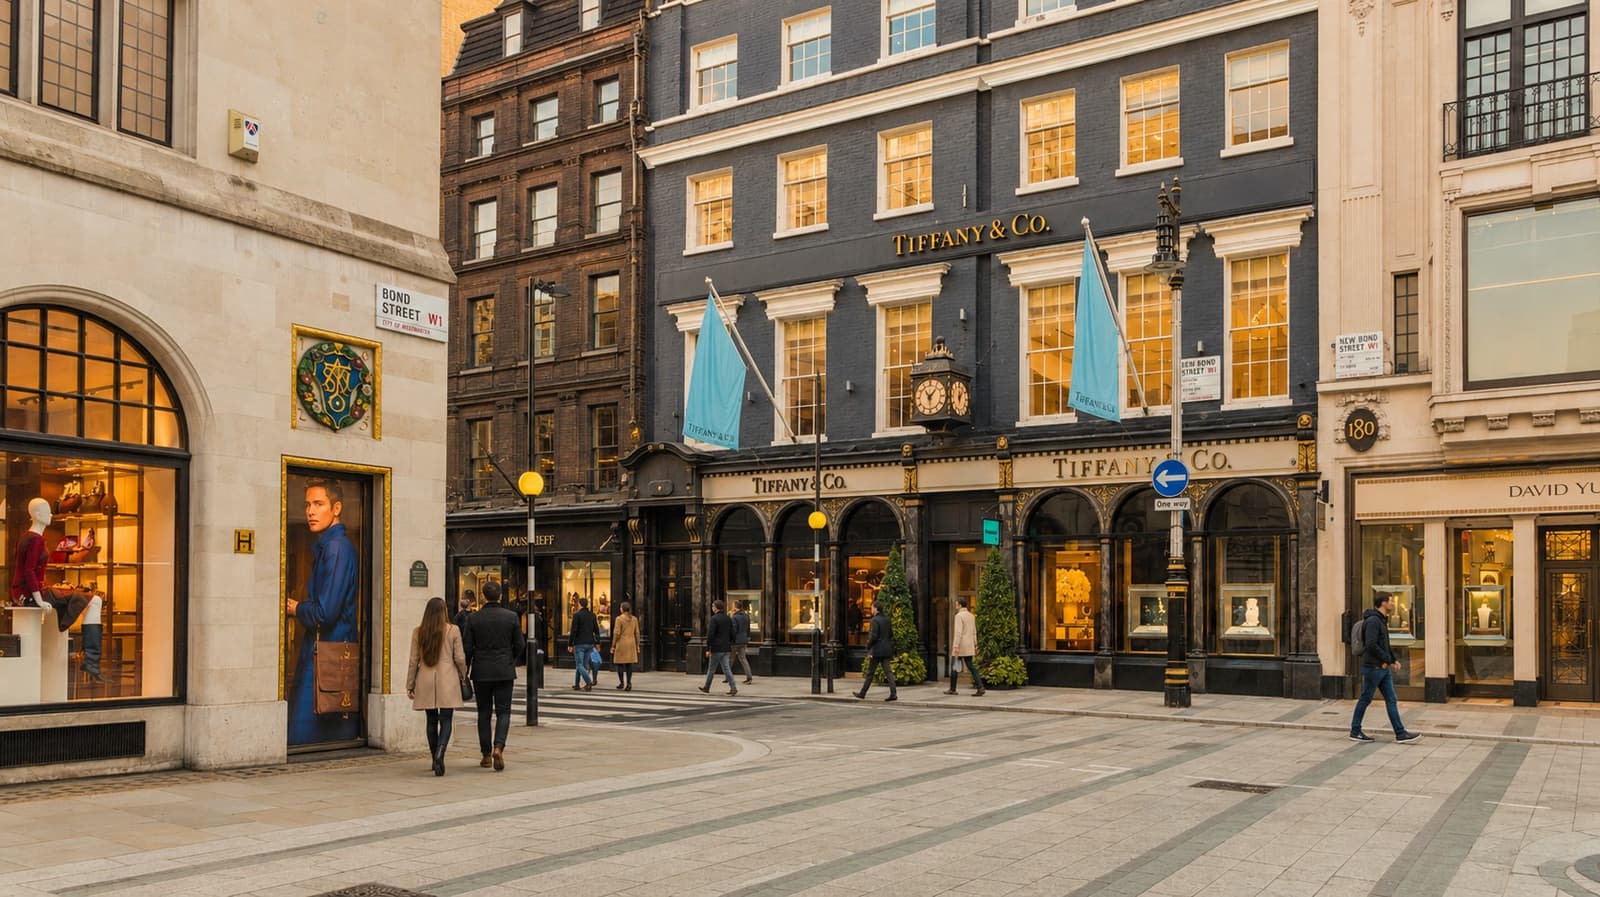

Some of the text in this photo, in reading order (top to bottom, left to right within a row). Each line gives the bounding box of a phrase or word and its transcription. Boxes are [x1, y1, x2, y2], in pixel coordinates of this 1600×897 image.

[892, 225, 985, 255] TIFFANY
[989, 219, 1006, 240] &
[382, 287, 410, 305] BOND
[382, 302, 442, 327] STREET W1
[1339, 334, 1378, 345] NEW BOND
[1339, 342, 1379, 353] STREET W1
[1348, 418, 1375, 440] 180
[1053, 457, 1156, 478] TIFFANY
[752, 477, 809, 494] TIFFANY
[1509, 484, 1569, 498] DAVID
[1156, 500, 1171, 508] One
